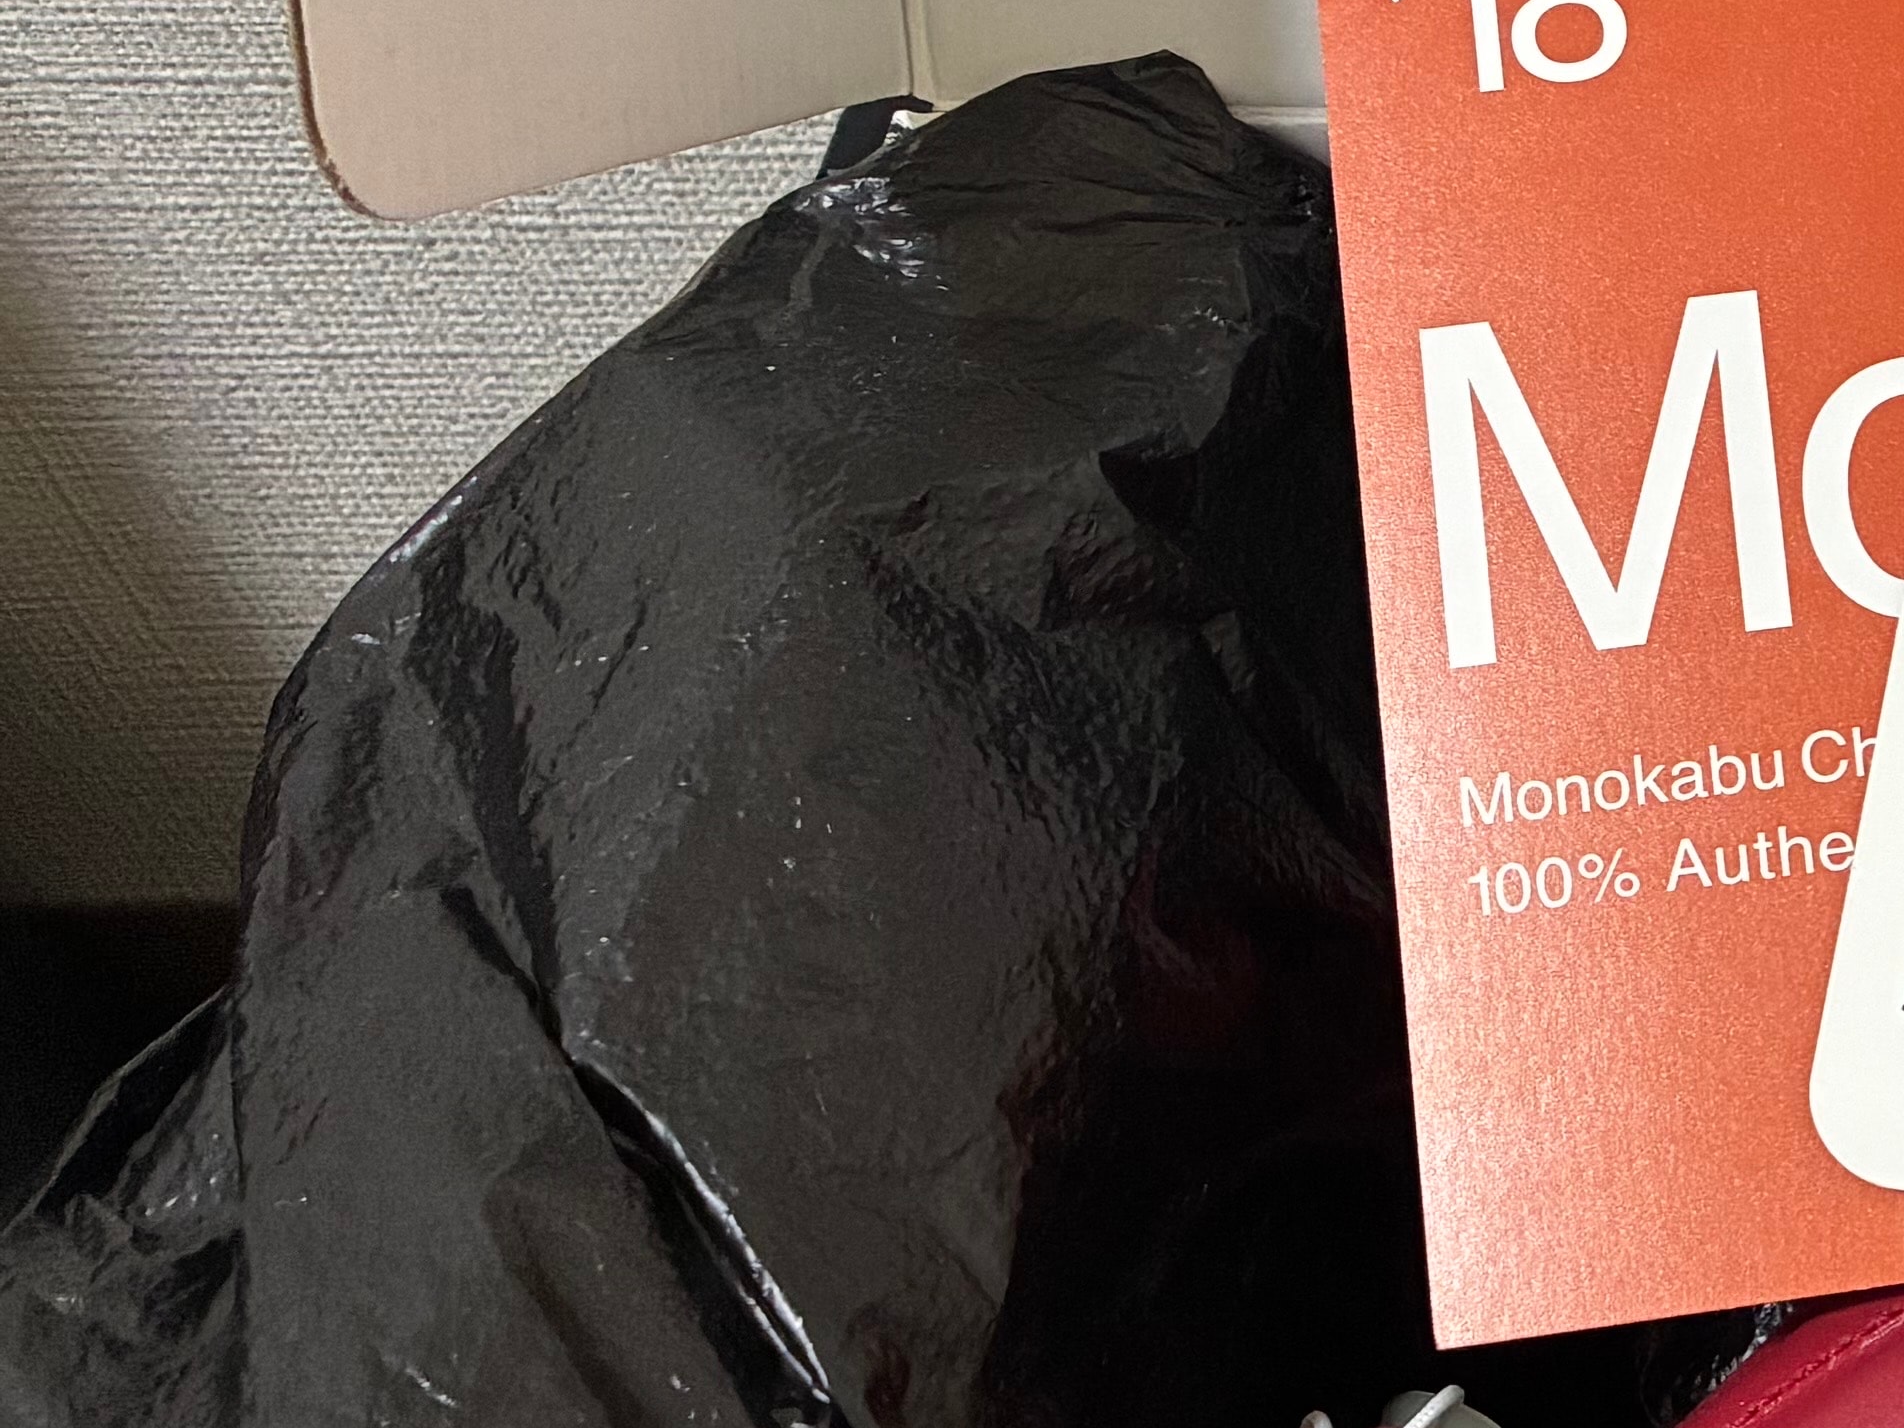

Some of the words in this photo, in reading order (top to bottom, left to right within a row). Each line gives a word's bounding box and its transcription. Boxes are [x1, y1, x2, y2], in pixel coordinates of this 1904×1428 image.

[1459, 745, 1784, 828] Monokabu
[1469, 848, 1641, 917] 100%
[1666, 826, 1856, 893] Authe
